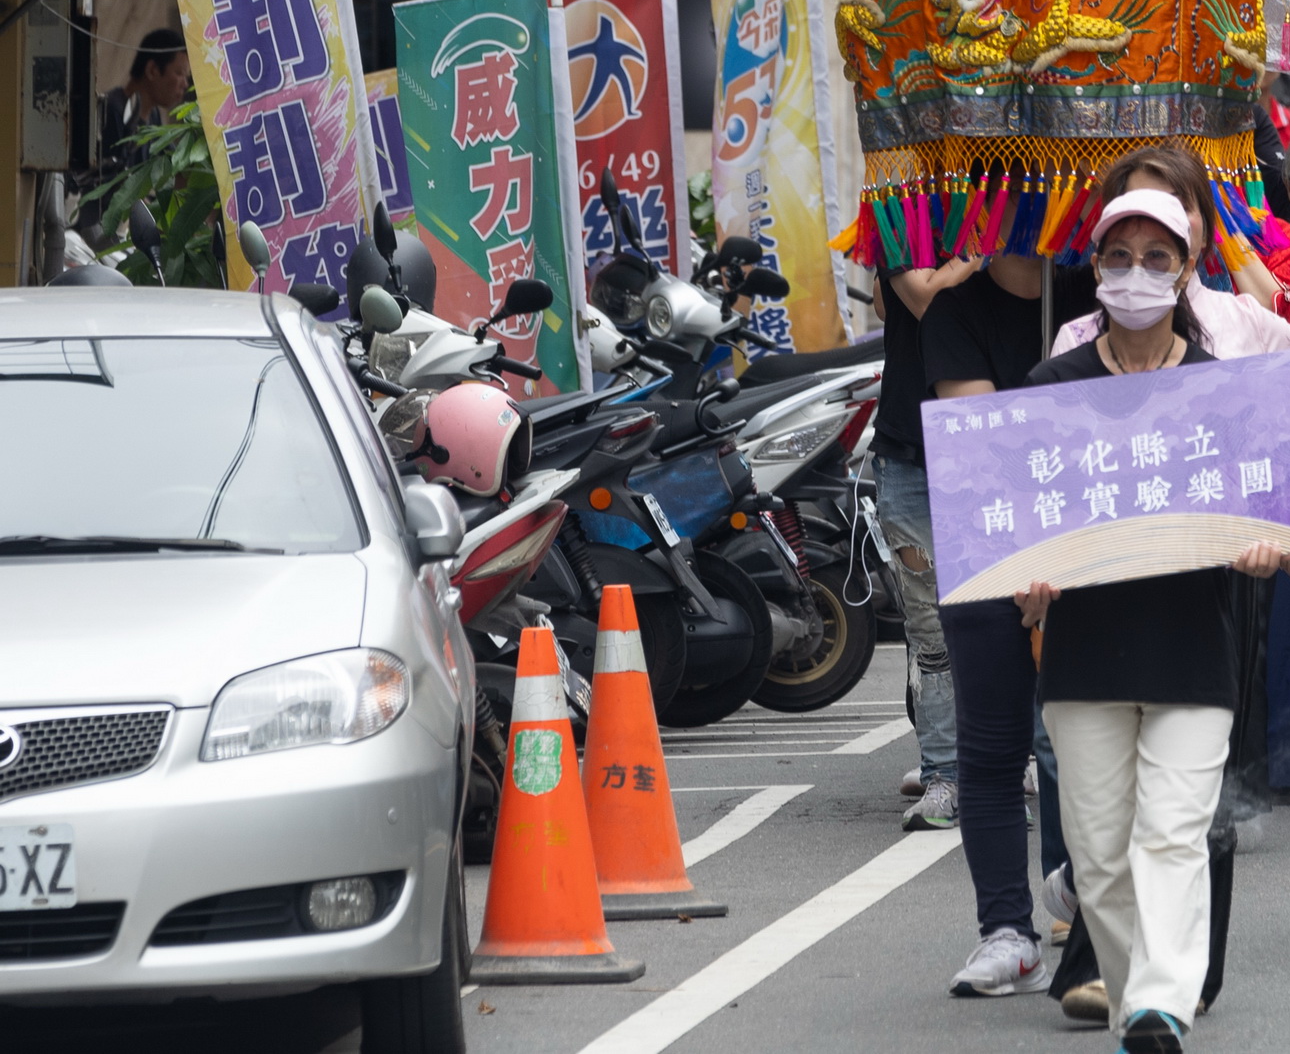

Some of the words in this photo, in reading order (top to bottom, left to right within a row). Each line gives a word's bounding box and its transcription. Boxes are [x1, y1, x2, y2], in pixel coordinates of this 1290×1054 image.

[1027, 425, 1219, 484] 彰化縣立
[981, 458, 1273, 537] 南管實驗樂團
